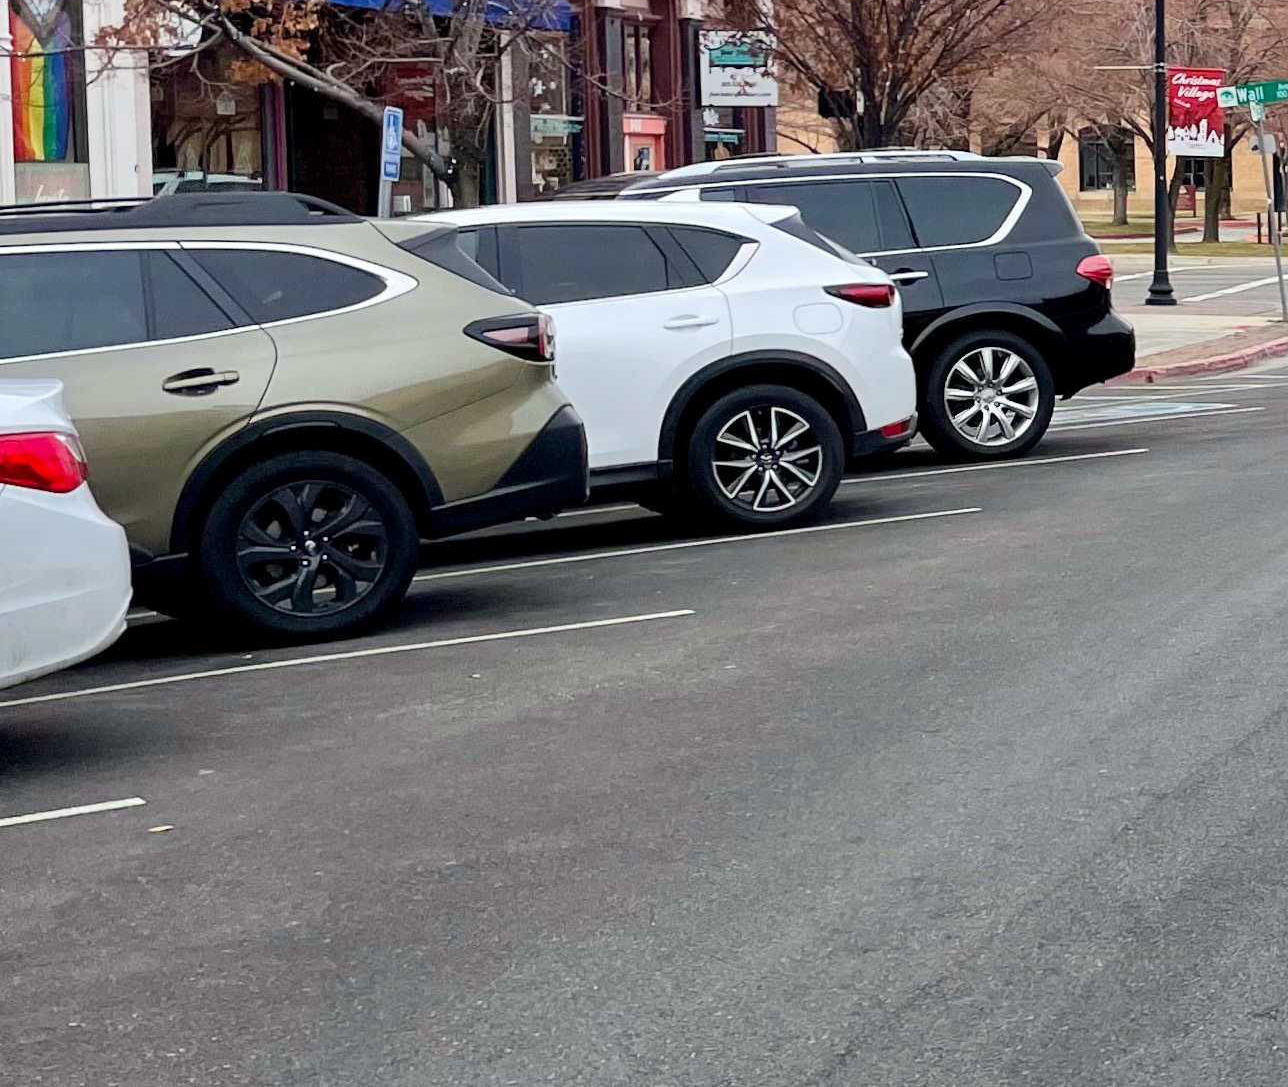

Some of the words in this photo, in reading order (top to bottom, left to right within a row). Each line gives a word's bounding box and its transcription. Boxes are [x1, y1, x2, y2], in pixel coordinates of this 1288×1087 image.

[1171, 72, 1222, 87] Christmas
[1177, 85, 1215, 102] Village
[1237, 86, 1264, 103] Wall
